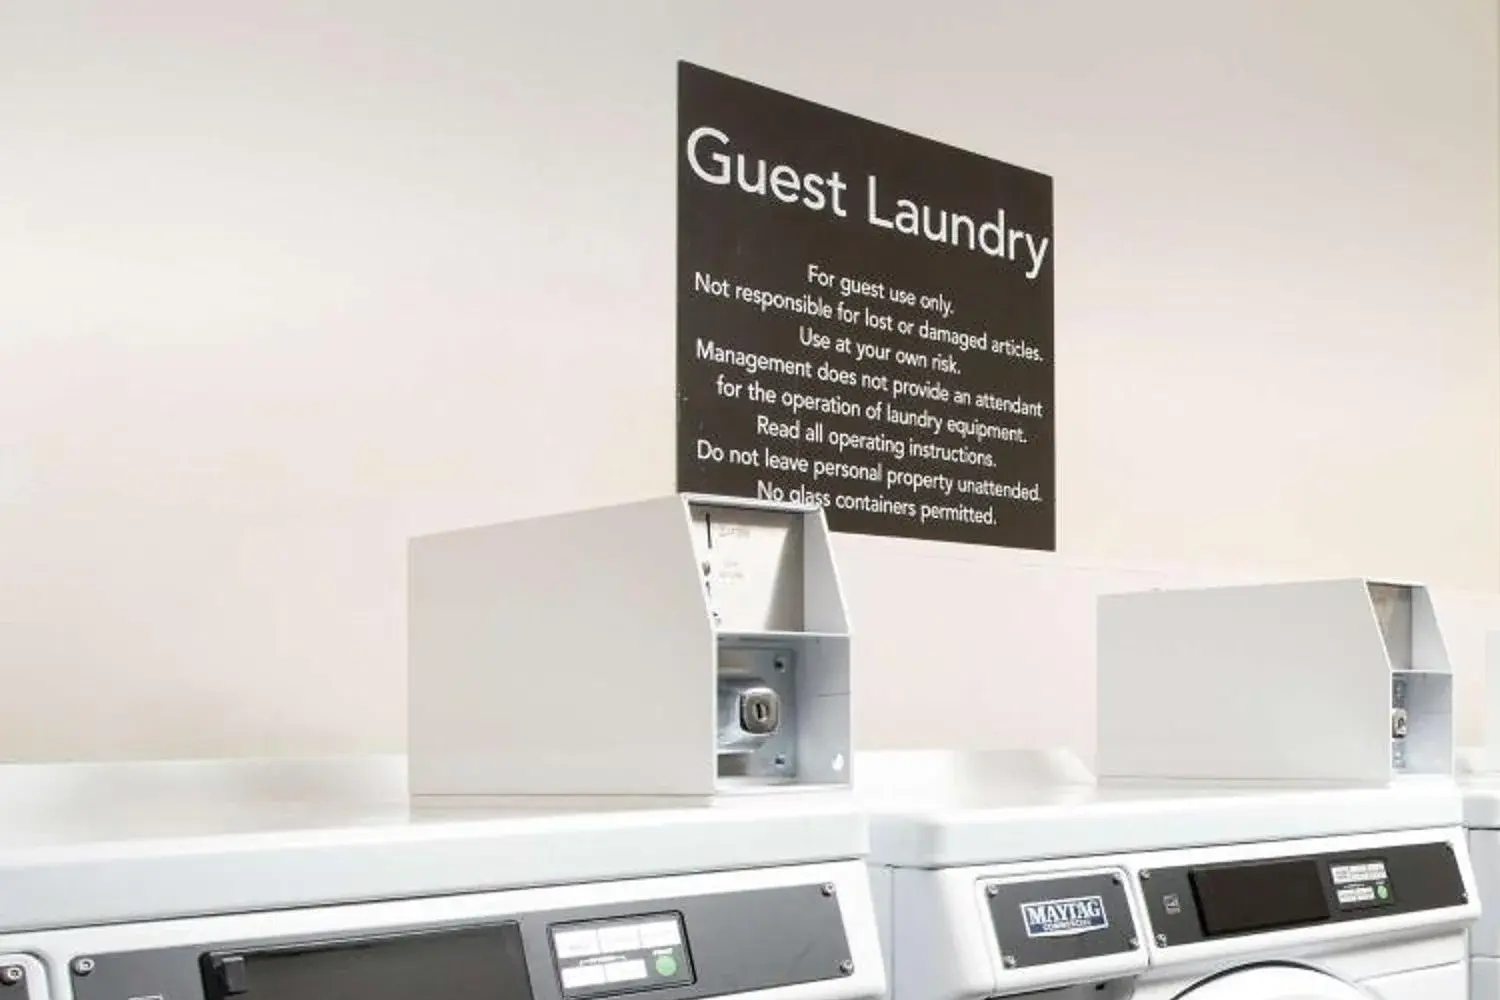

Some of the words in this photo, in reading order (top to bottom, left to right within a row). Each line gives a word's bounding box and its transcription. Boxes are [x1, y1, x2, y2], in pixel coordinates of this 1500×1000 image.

[687, 126, 848, 218] Guest
[868, 175, 1049, 279] Laundry
[695, 271, 731, 298] Not
[735, 286, 833, 319] responsible
[837, 301, 860, 324] for
[865, 306, 894, 331] lost
[897, 321, 915, 335] or
[919, 320, 988, 351] damaged
[991, 338, 1044, 362] articles.
[807, 264, 835, 287] For
[840, 276, 885, 298] guest
[890, 288, 915, 306] use
[919, 293, 955, 317] only.
[696, 338, 812, 378] Management
[817, 361, 857, 386] does
[861, 372, 888, 391] not
[893, 377, 949, 402] provide
[953, 390, 971, 405] an
[975, 393, 1043, 417] attendant
[799, 326, 831, 349] Use
[835, 336, 851, 354] at
[856, 342, 891, 361] your
[896, 351, 927, 368] own
[932, 353, 961, 374] risk.
[715, 374, 742, 398] for
[748, 381, 777, 403] the
[782, 391, 861, 416] operation
[865, 401, 883, 420] of
[887, 404, 943, 434] laundry
[947, 418, 1027, 443] equipment.
[757, 415, 800, 439] Read
[805, 422, 824, 442] all
[828, 431, 905, 458] operating
[909, 437, 997, 467] instructions.
[697, 439, 724, 461] Do
[729, 448, 759, 466] not
[765, 447, 809, 472] leave
[813, 461, 883, 481] personal
[887, 470, 953, 494] property
[957, 479, 1043, 501] unattended.
[757, 480, 784, 501] No
[789, 483, 831, 507] glass
[835, 495, 916, 517] containers
[921, 503, 998, 525] permitted.
[1027, 900, 1101, 925] MAYTAG
